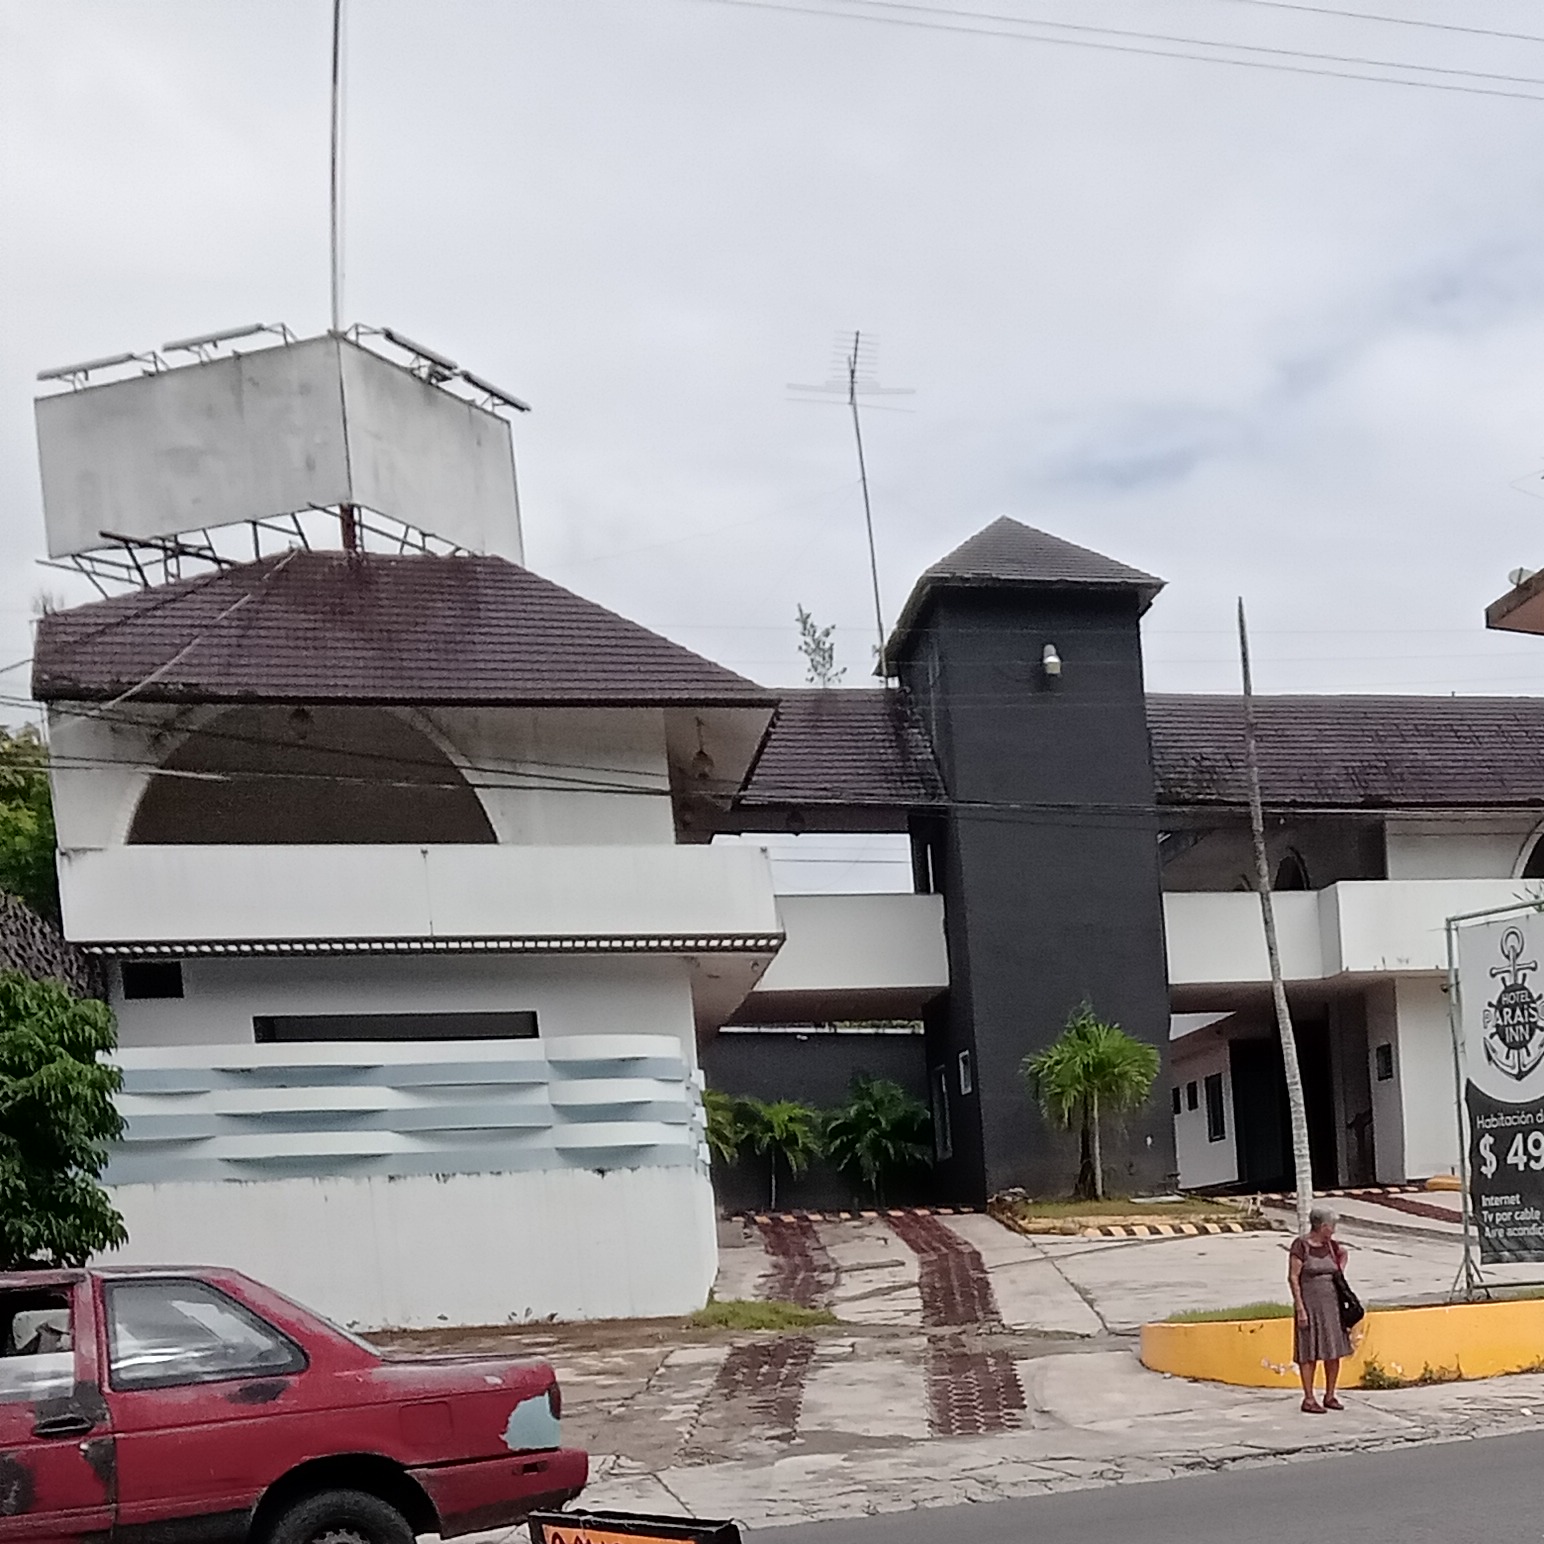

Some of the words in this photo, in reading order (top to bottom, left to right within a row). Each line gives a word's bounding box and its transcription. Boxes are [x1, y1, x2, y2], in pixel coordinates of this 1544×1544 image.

[1502, 990, 1531, 1005] HOTEL
[1505, 1024, 1530, 1043] INN
[1476, 1110, 1534, 1129] Habitación
[1481, 1193, 1521, 1207] Internet
[1481, 1210, 1494, 1222] Tv
[1495, 1211, 1512, 1224] por
[1514, 1207, 1541, 1220] cable
[1484, 1226, 1505, 1238] Aire
